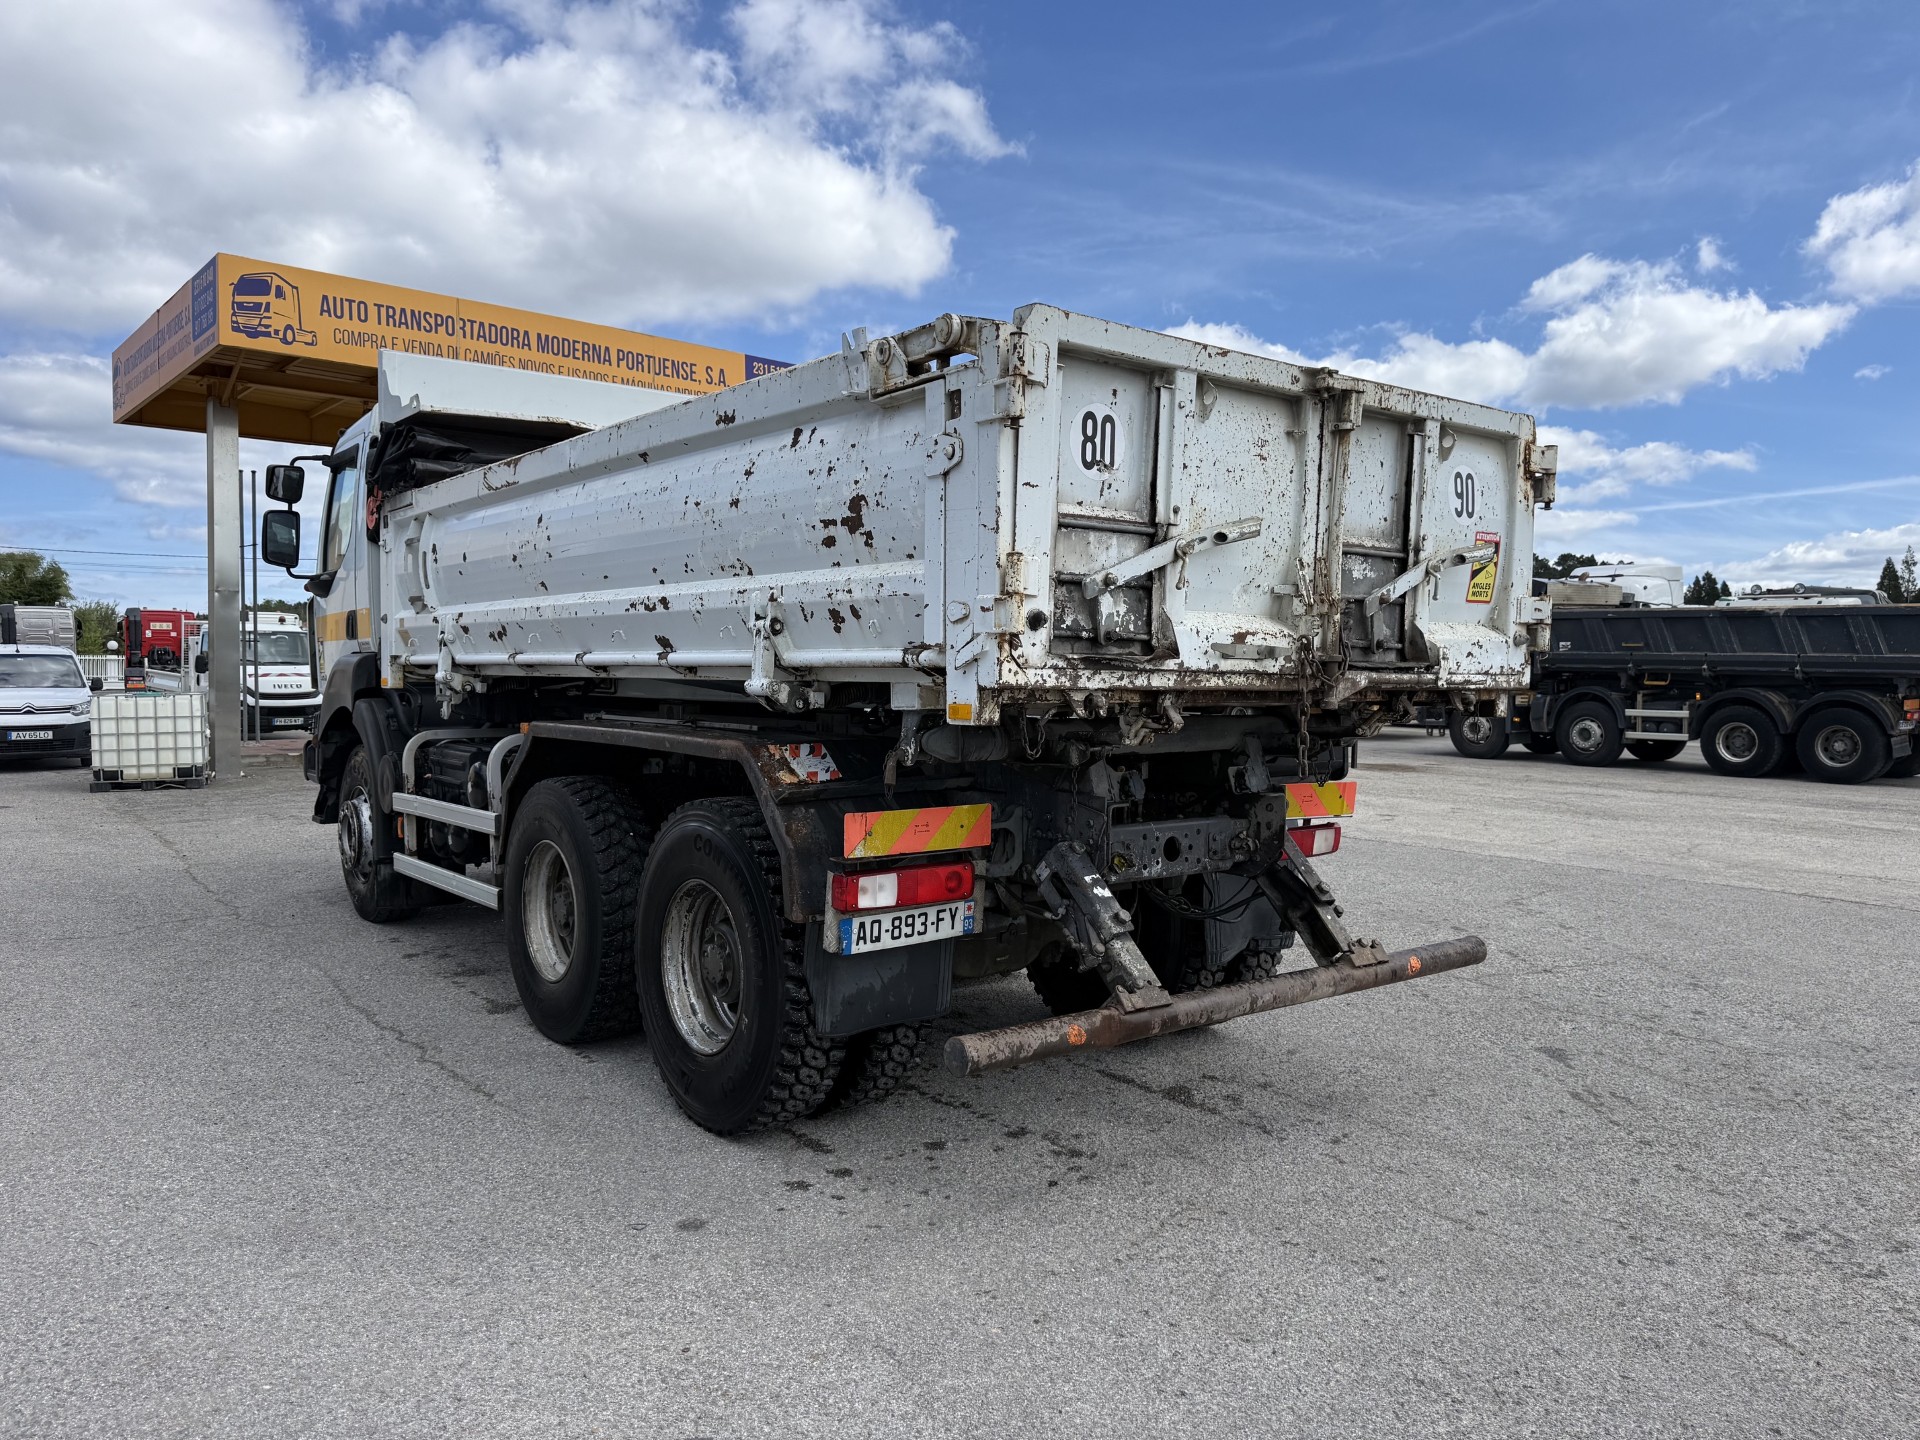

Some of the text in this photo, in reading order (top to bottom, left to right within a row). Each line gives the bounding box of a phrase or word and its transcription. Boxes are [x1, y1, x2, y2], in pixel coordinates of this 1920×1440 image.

[319, 294, 730, 388] AUTO TRANSPORTADORA MODERNA PORTUENSE, S.A.
[333, 327, 388, 350] COMPRA
[391, 336, 399, 350] E
[402, 337, 444, 358] VENDA
[464, 348, 516, 369] CAMIÕES
[518, 357, 556, 375] NOVOS
[558, 364, 565, 376] E
[752, 361, 768, 376] 231
[1080, 410, 1116, 470] 80
[1453, 471, 1475, 519] 90
[1470, 590, 1489, 598] MORTS
[1471, 582, 1492, 590] ANGLES
[855, 906, 960, 947] AQ-893-FY
[963, 918, 974, 931] 93
